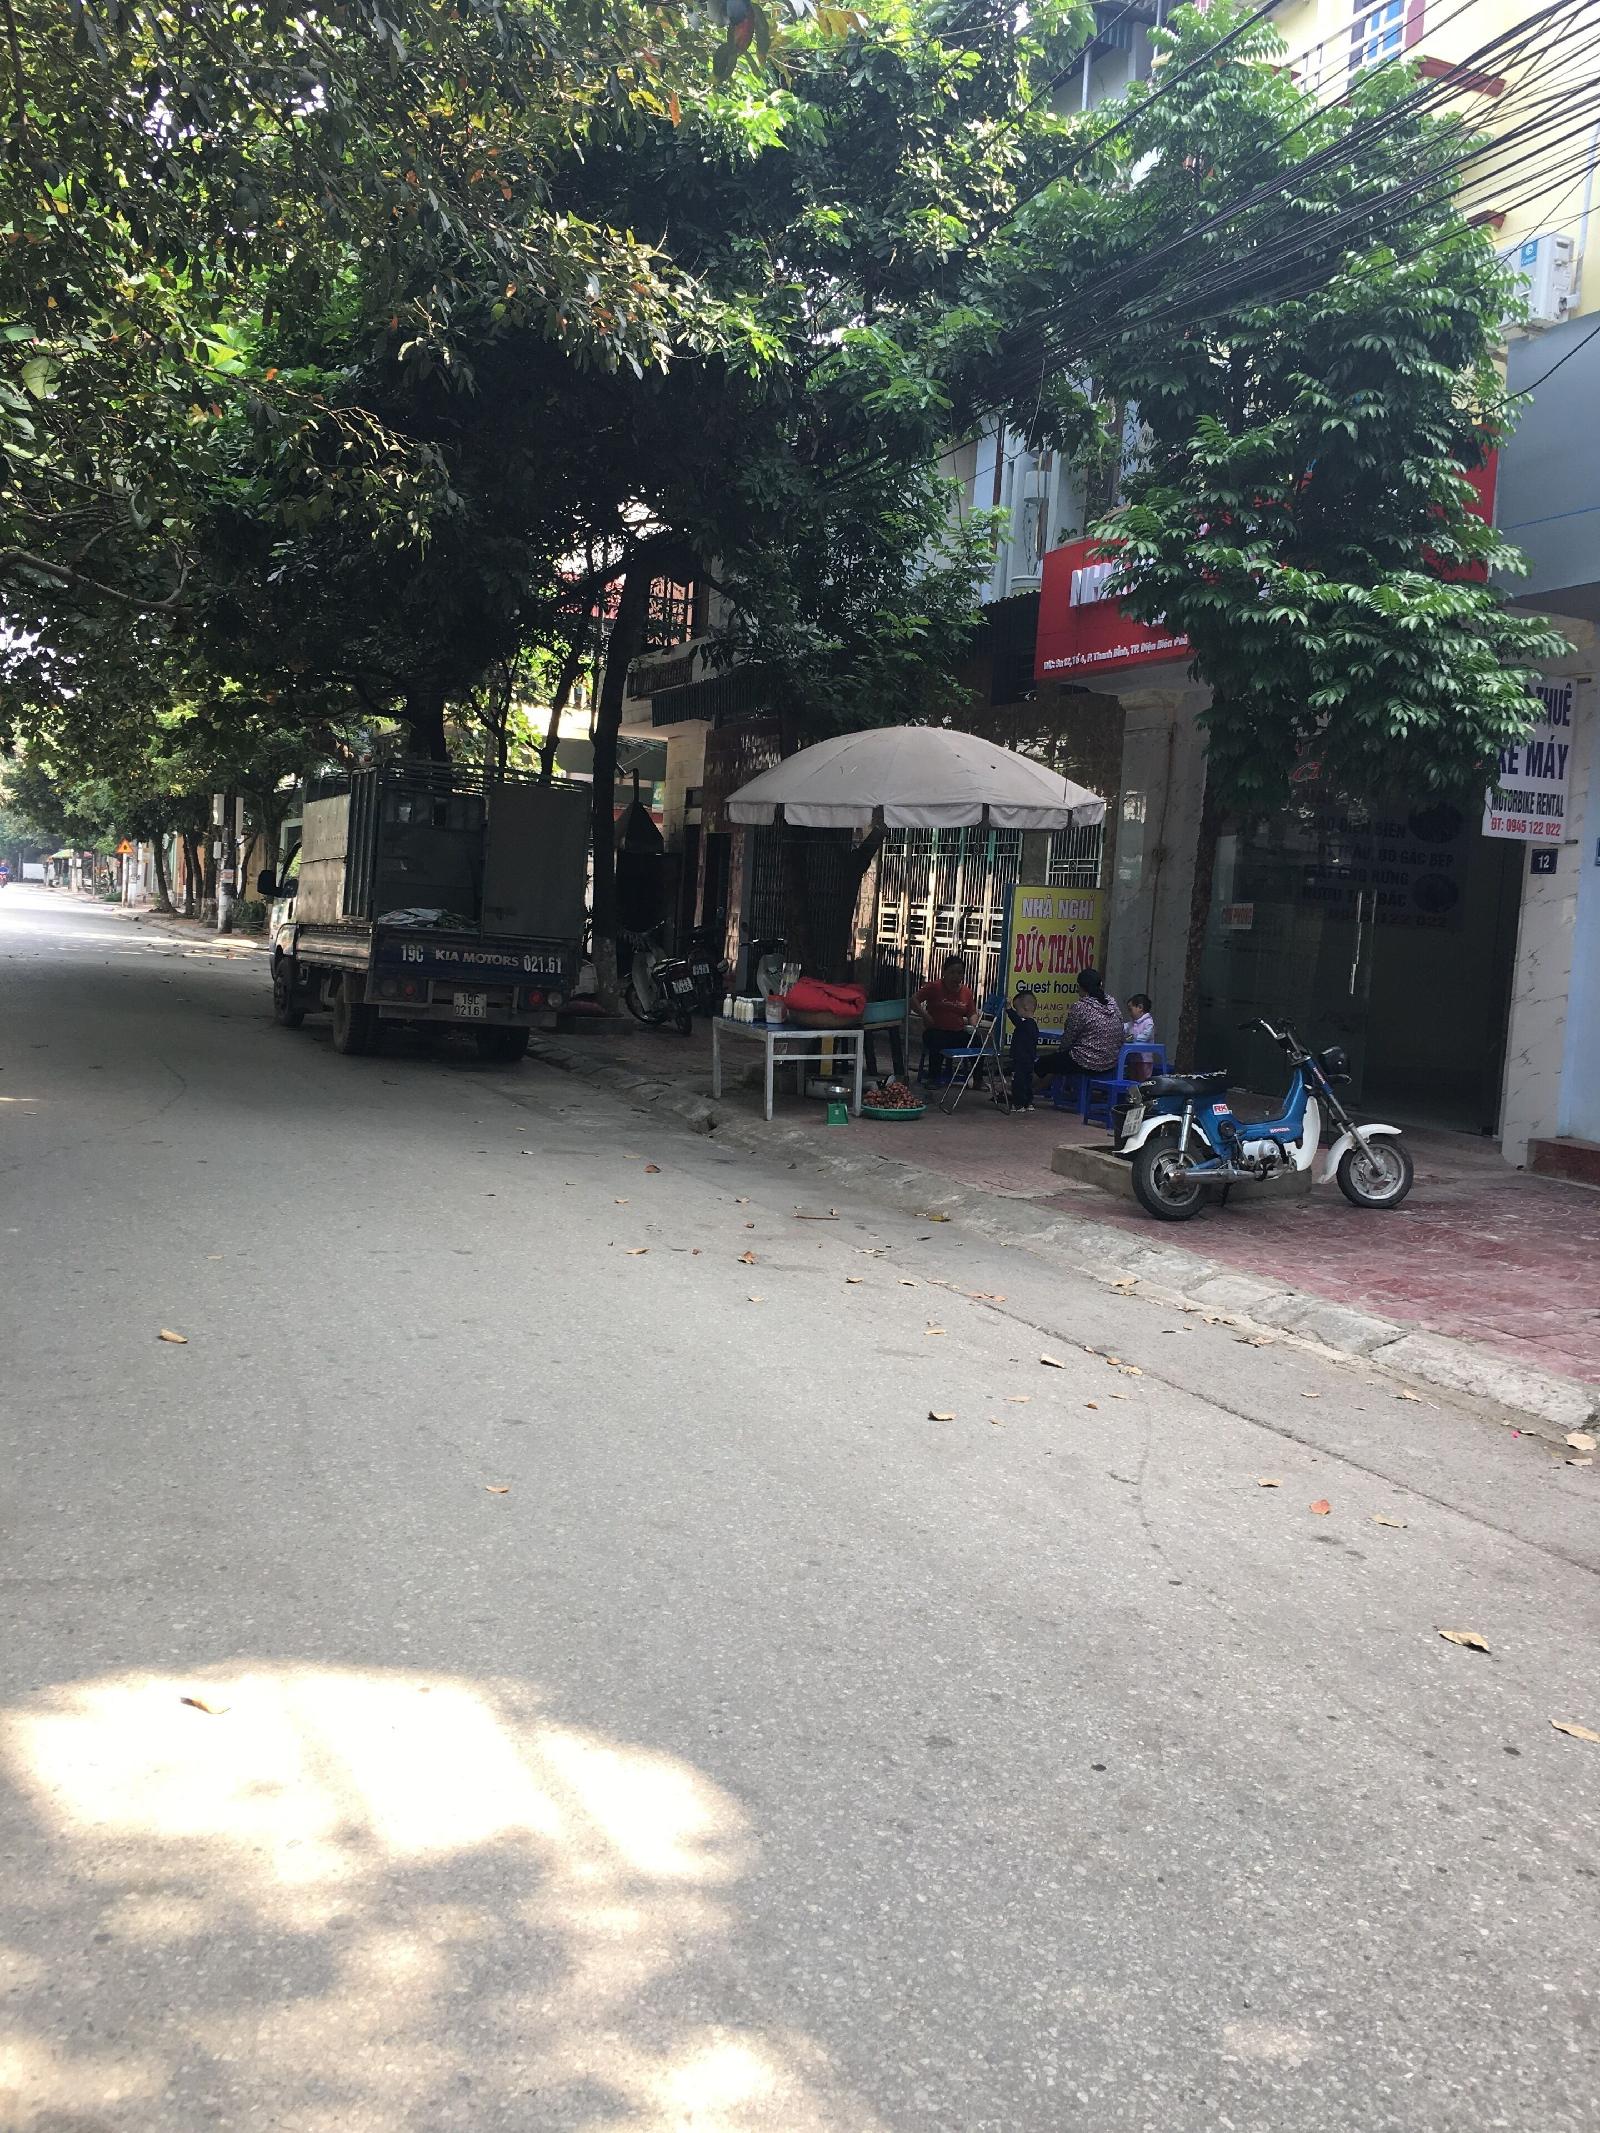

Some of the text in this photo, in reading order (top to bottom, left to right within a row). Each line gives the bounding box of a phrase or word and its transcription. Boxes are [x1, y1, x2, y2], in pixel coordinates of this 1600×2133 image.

[1526, 735, 1569, 780] MÁY
[1491, 788, 1564, 818] MOTORBIKE RENTAL
[1507, 818, 1527, 834] 0945
[1529, 820, 1543, 835] 122
[1546, 822, 1561, 837] 022
[1538, 856, 1550, 868] 12
[1022, 894, 1053, 919] NHÀ
[400, 944, 562, 973] 19C KIA MOTORS 021.61
[1014, 924, 1095, 974] ĐỨC THẮNG
[463, 993, 480, 1005] 19C
[1016, 979, 1079, 994] Guest hou
